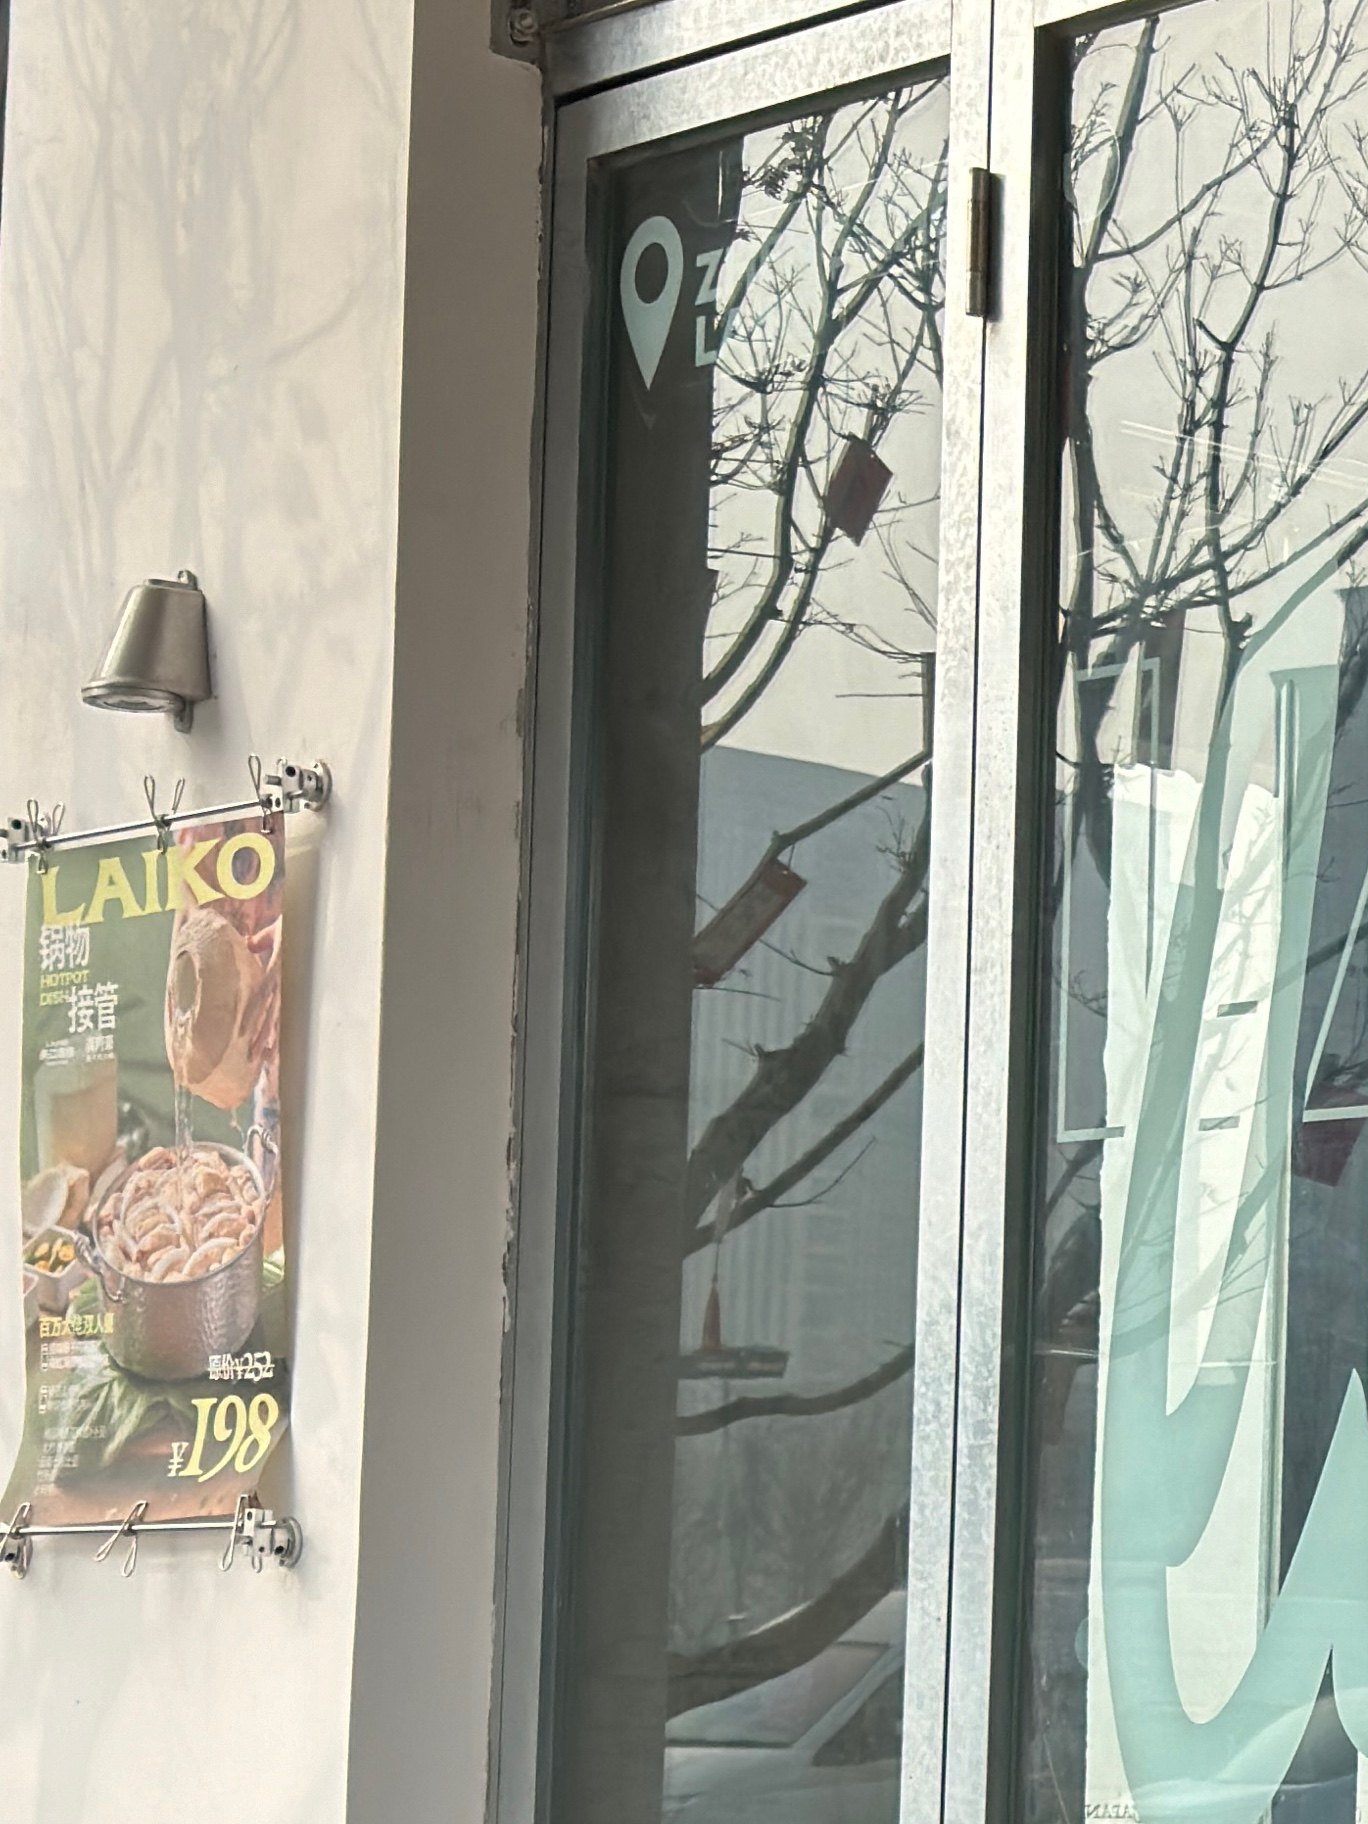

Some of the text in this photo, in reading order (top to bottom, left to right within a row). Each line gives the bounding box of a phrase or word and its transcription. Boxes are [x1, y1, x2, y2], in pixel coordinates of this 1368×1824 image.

[41, 832, 276, 928] LAIKO
[40, 969, 89, 988] HOTPOT
[67, 981, 119, 1034] 接管
[167, 1393, 279, 1483] ¥198
